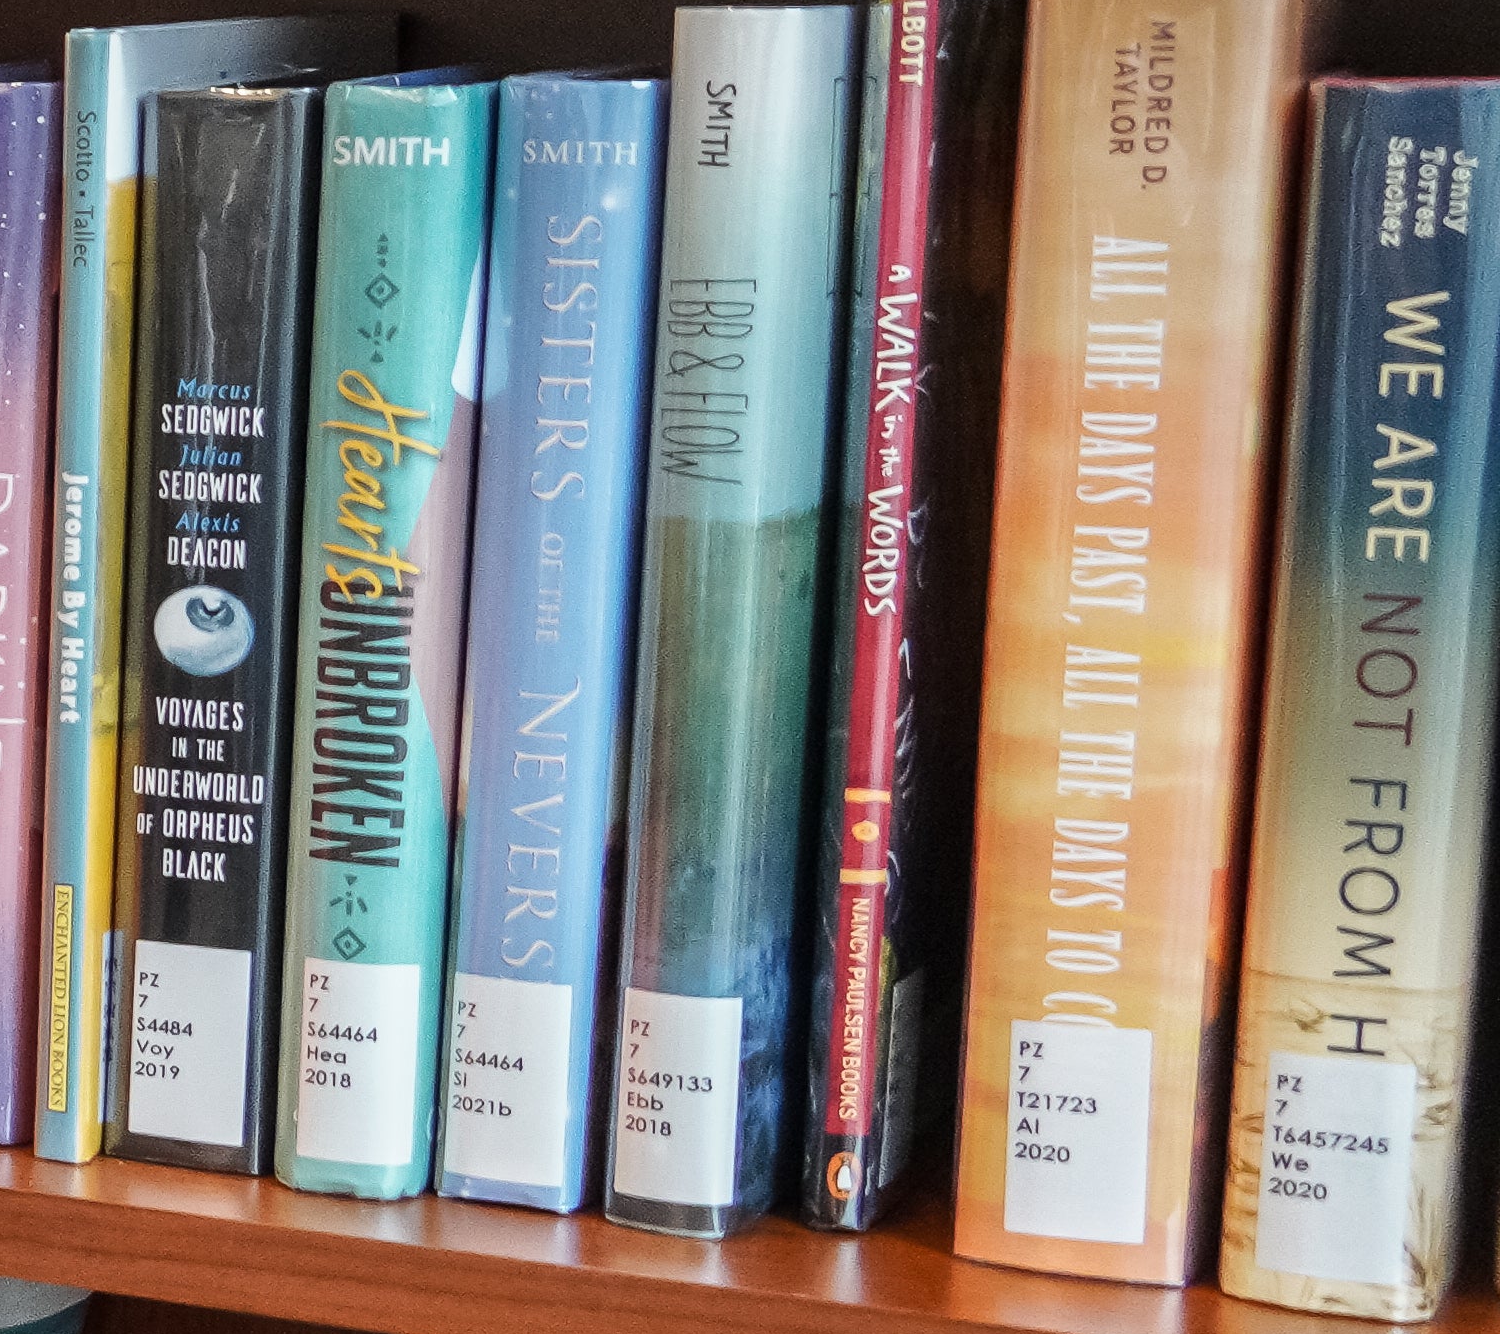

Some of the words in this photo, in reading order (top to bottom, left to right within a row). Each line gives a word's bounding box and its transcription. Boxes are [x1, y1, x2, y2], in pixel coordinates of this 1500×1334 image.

[1107, 43, 1142, 158] TAYLOR
[1145, 20, 1178, 149] MILDRED
[700, 79, 738, 170] SMITH
[74, 109, 96, 182] Scotto
[333, 137, 451, 168] SMITH
[522, 138, 639, 167] SMITH
[529, 214, 603, 504] SISTERS
[1375, 289, 1454, 402] WE
[160, 405, 266, 438] SEDGWICK
[1075, 403, 1158, 507] DAYS
[158, 471, 261, 504] SEDGWICK
[320, 369, 439, 604] Hearts
[1364, 421, 1440, 565] ARE
[62, 473, 89, 583] Jerome
[168, 537, 246, 569] DEACON
[59, 625, 86, 724] Heart
[1351, 591, 1424, 750] NOT
[156, 697, 245, 731] VOYAGES
[133, 766, 265, 805] UNDERWORLD
[162, 810, 254, 843] ORPHEUS
[162, 848, 226, 882] BLACK
[1331, 773, 1410, 984] FROM
[136, 1017, 193, 1038] S4484
[308, 1022, 378, 1043] S64464
[136, 1040, 175, 1059] Voy
[135, 1061, 180, 1080] 2019
[305, 1069, 351, 1089] 2018
[627, 1068, 713, 1092] S649133
[452, 1096, 512, 1117] 2021b
[1017, 1091, 1097, 1114] T21723
[625, 1115, 672, 1137] 2018
[1274, 1124, 1389, 1155] T6457245
[1015, 1143, 1070, 1163] 2020
[1269, 1178, 1327, 1201] 2020
